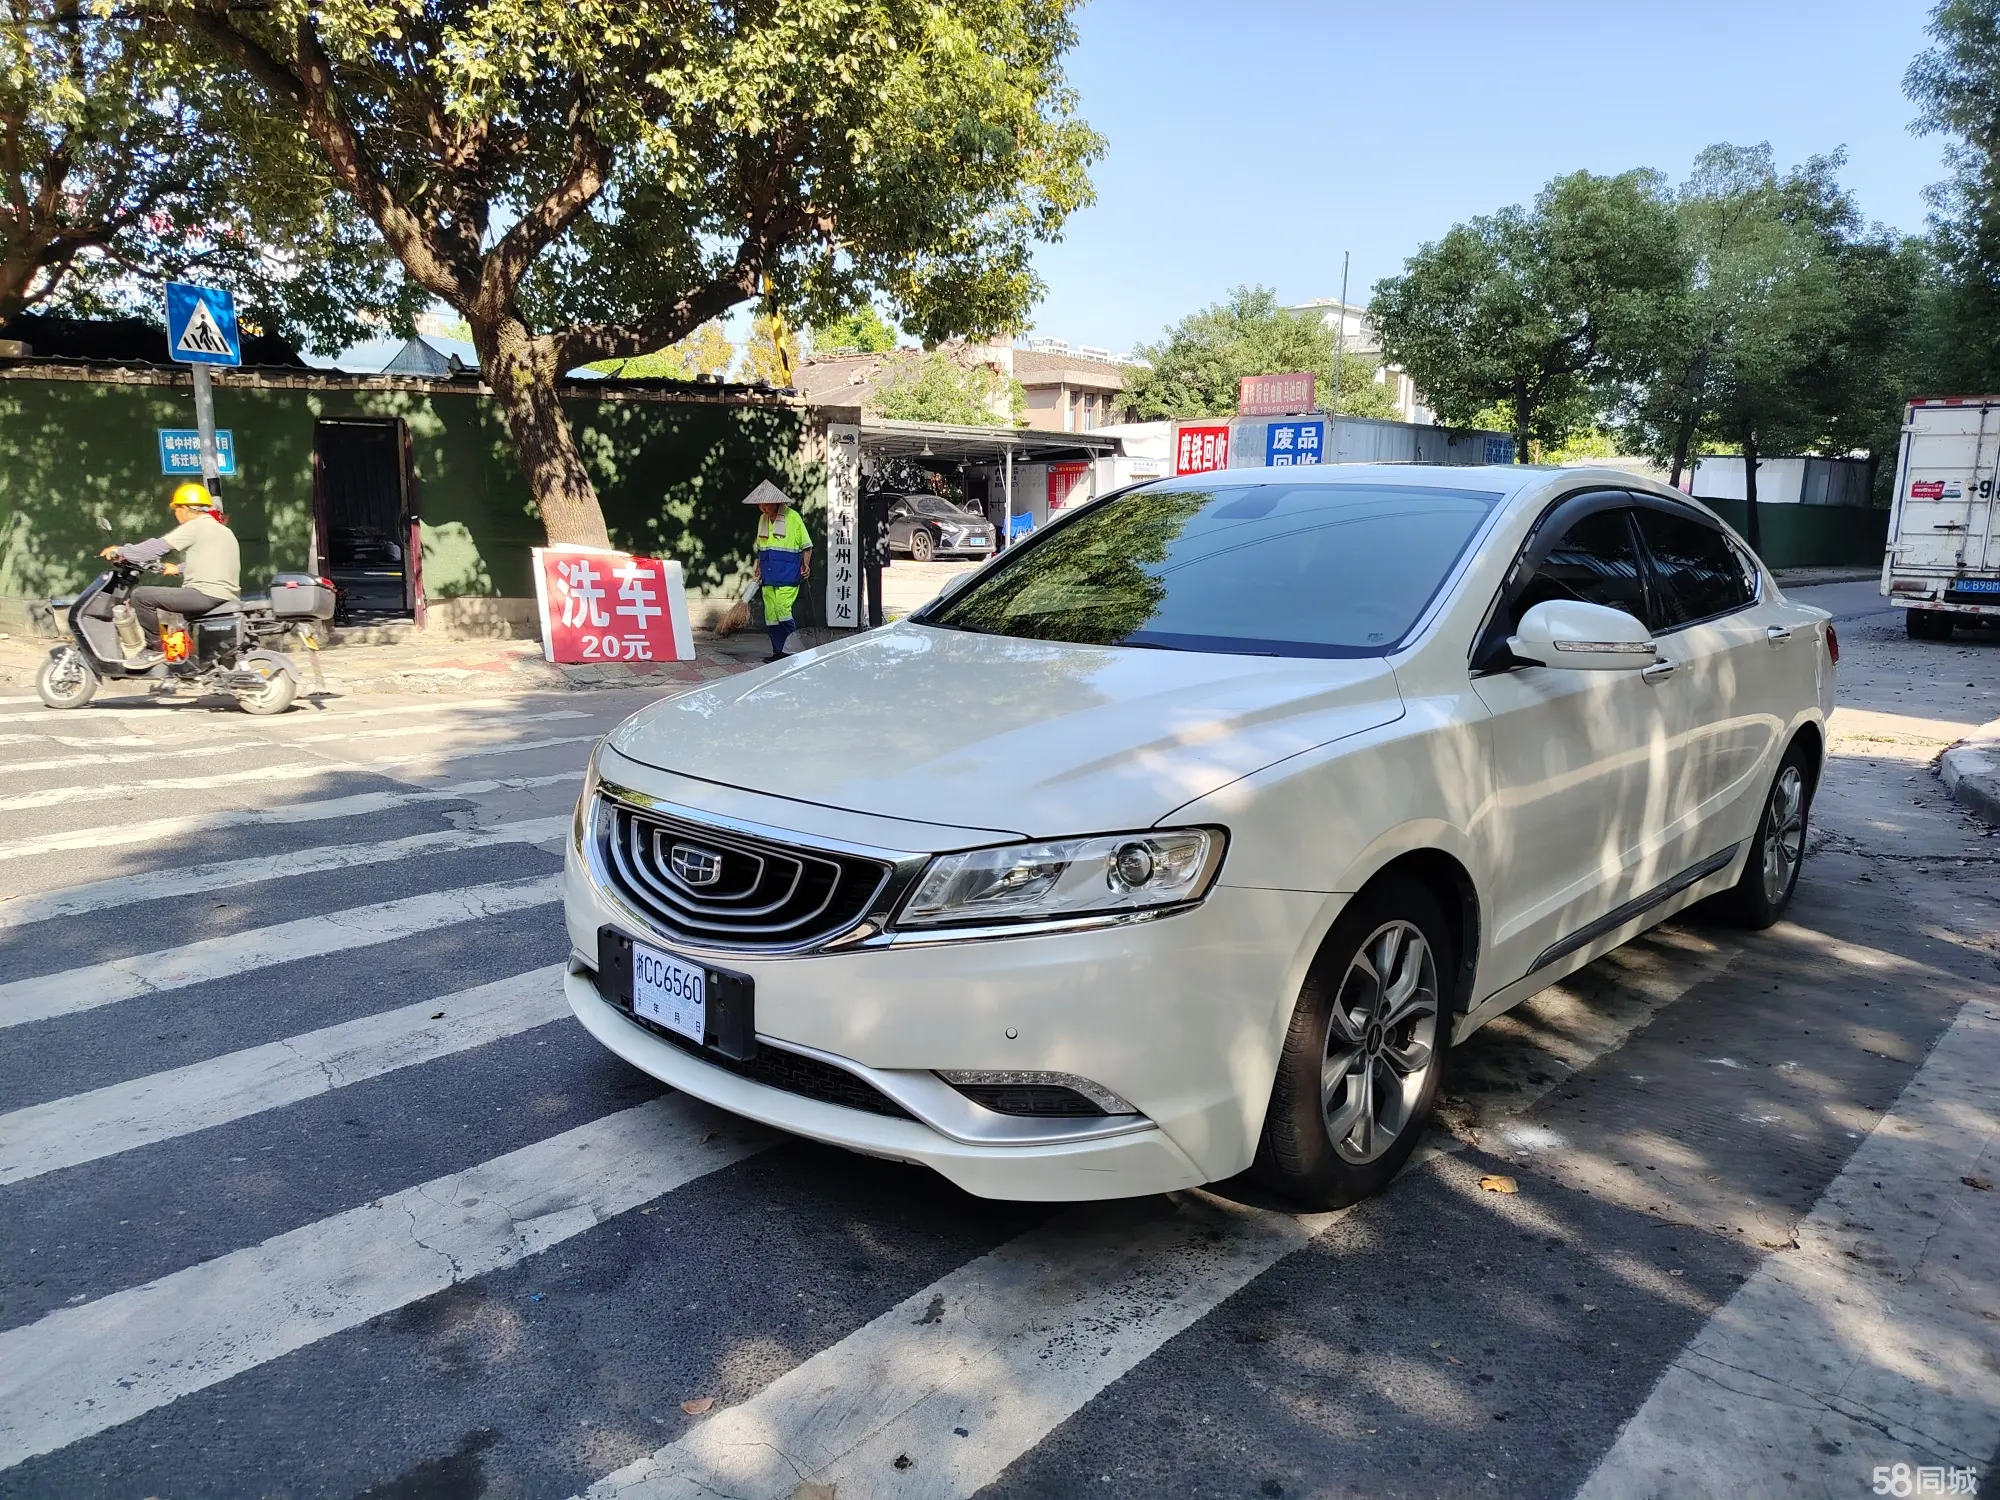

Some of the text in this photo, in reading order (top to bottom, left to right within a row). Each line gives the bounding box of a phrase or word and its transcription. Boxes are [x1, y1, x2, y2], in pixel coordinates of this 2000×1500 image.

[165, 436, 229, 450] 城中村改目
[1272, 426, 1318, 450] 废品
[171, 453, 227, 467] 拆迁地围
[1179, 432, 1227, 471] 废铁回收
[556, 560, 662, 630] 洗车
[581, 634, 653, 660] 20元
[636, 952, 702, 1005] 浙CC6560
